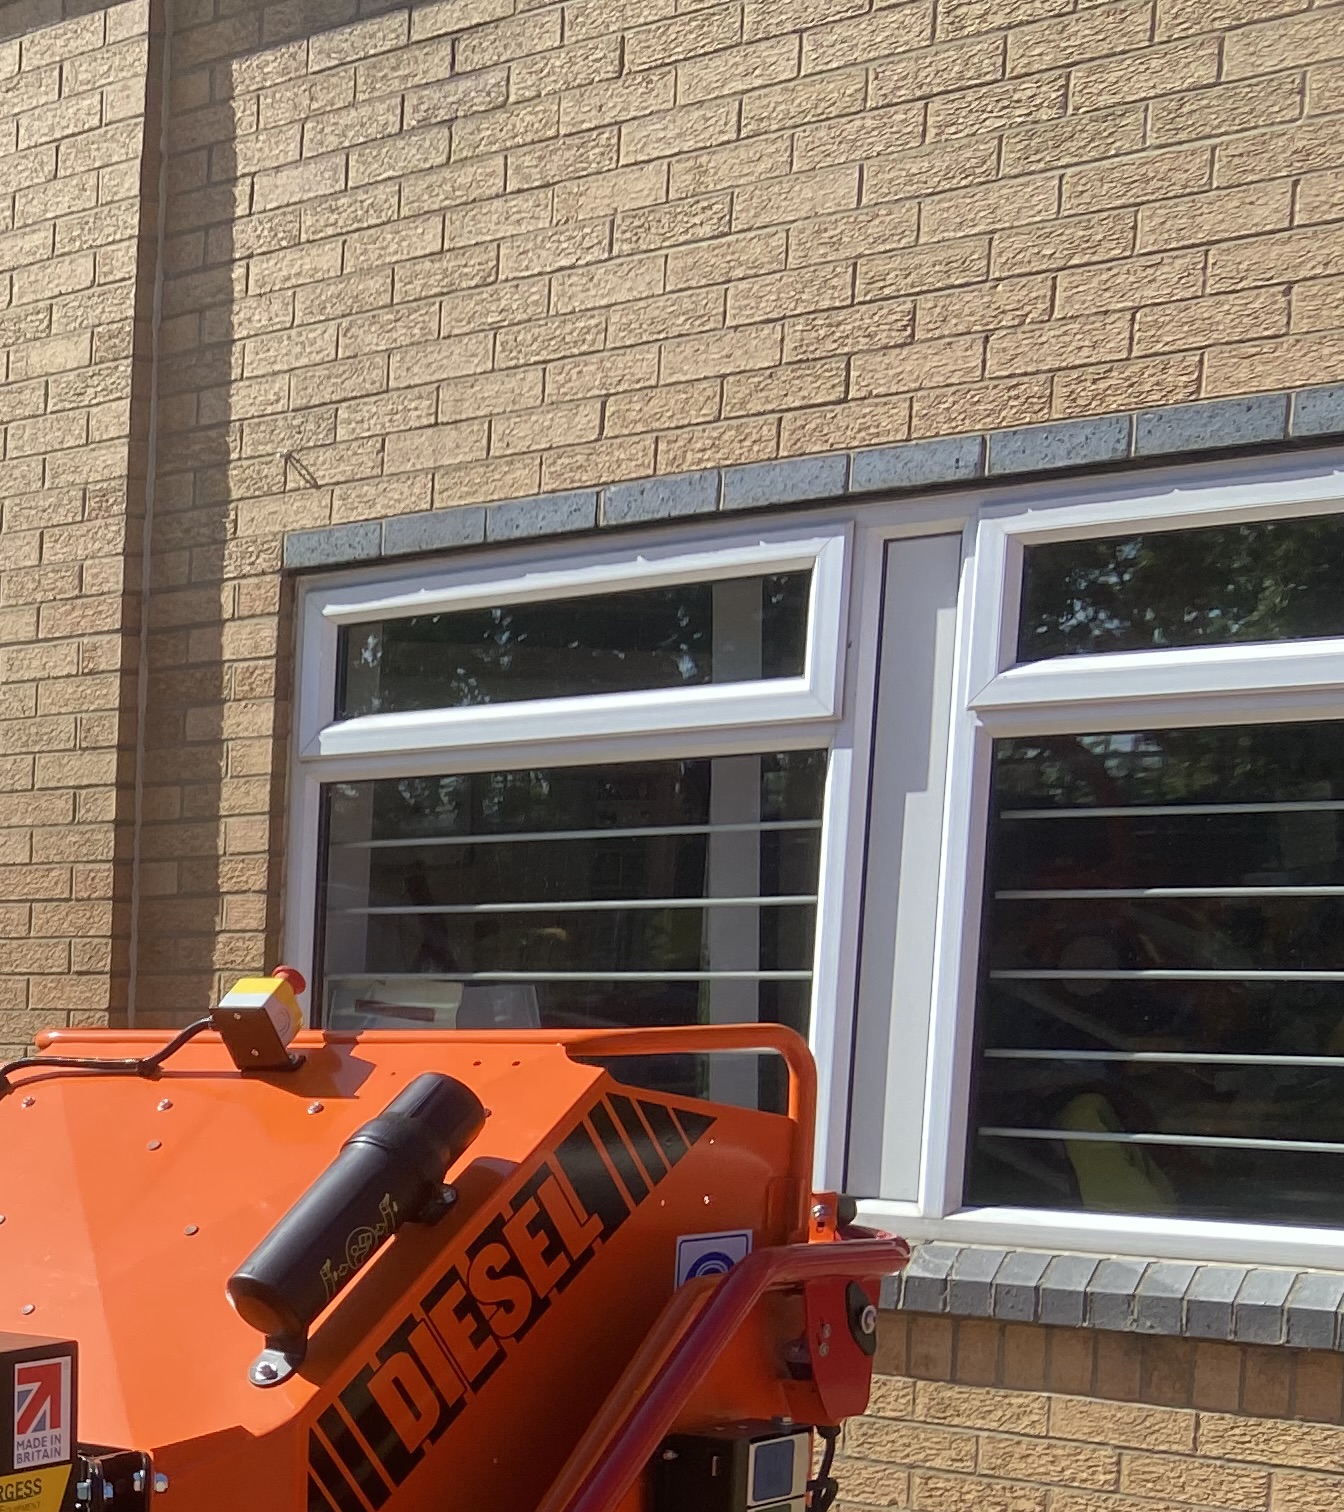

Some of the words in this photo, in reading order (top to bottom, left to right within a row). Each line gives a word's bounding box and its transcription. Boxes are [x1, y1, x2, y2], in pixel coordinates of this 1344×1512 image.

[367, 1174, 604, 1454] DIESEL
[16, 1436, 48, 1451] MADE
[50, 1433, 62, 1445] IN
[16, 1446, 62, 1464] BRITAIN
